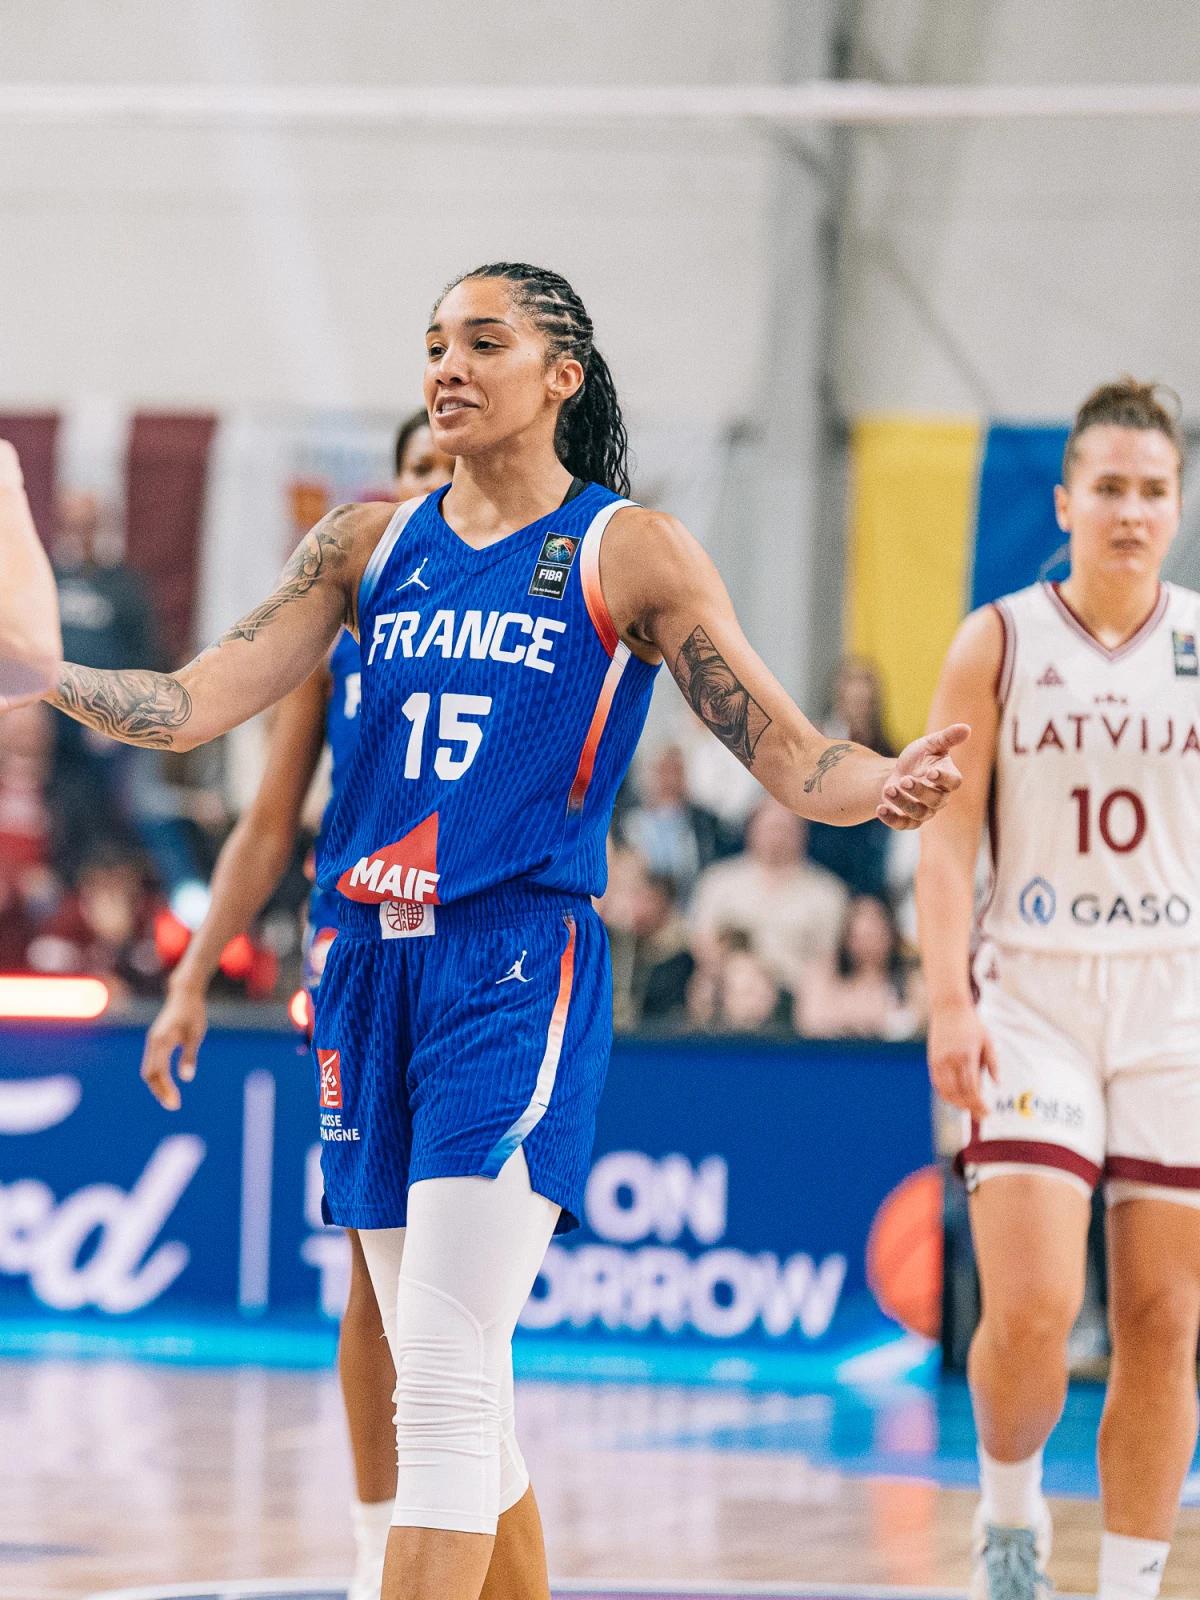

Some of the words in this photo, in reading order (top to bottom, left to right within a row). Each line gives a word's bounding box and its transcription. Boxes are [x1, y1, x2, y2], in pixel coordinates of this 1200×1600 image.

[538, 568, 563, 583] FIBA
[366, 609, 567, 675] FRANCE
[401, 692, 493, 781] 15
[1012, 714, 1200, 756] LATVIJA
[1071, 783, 1148, 856] 10
[349, 856, 441, 902] MAIF
[1071, 893, 1191, 928] GASO
[586, 1150, 730, 1243] ON
